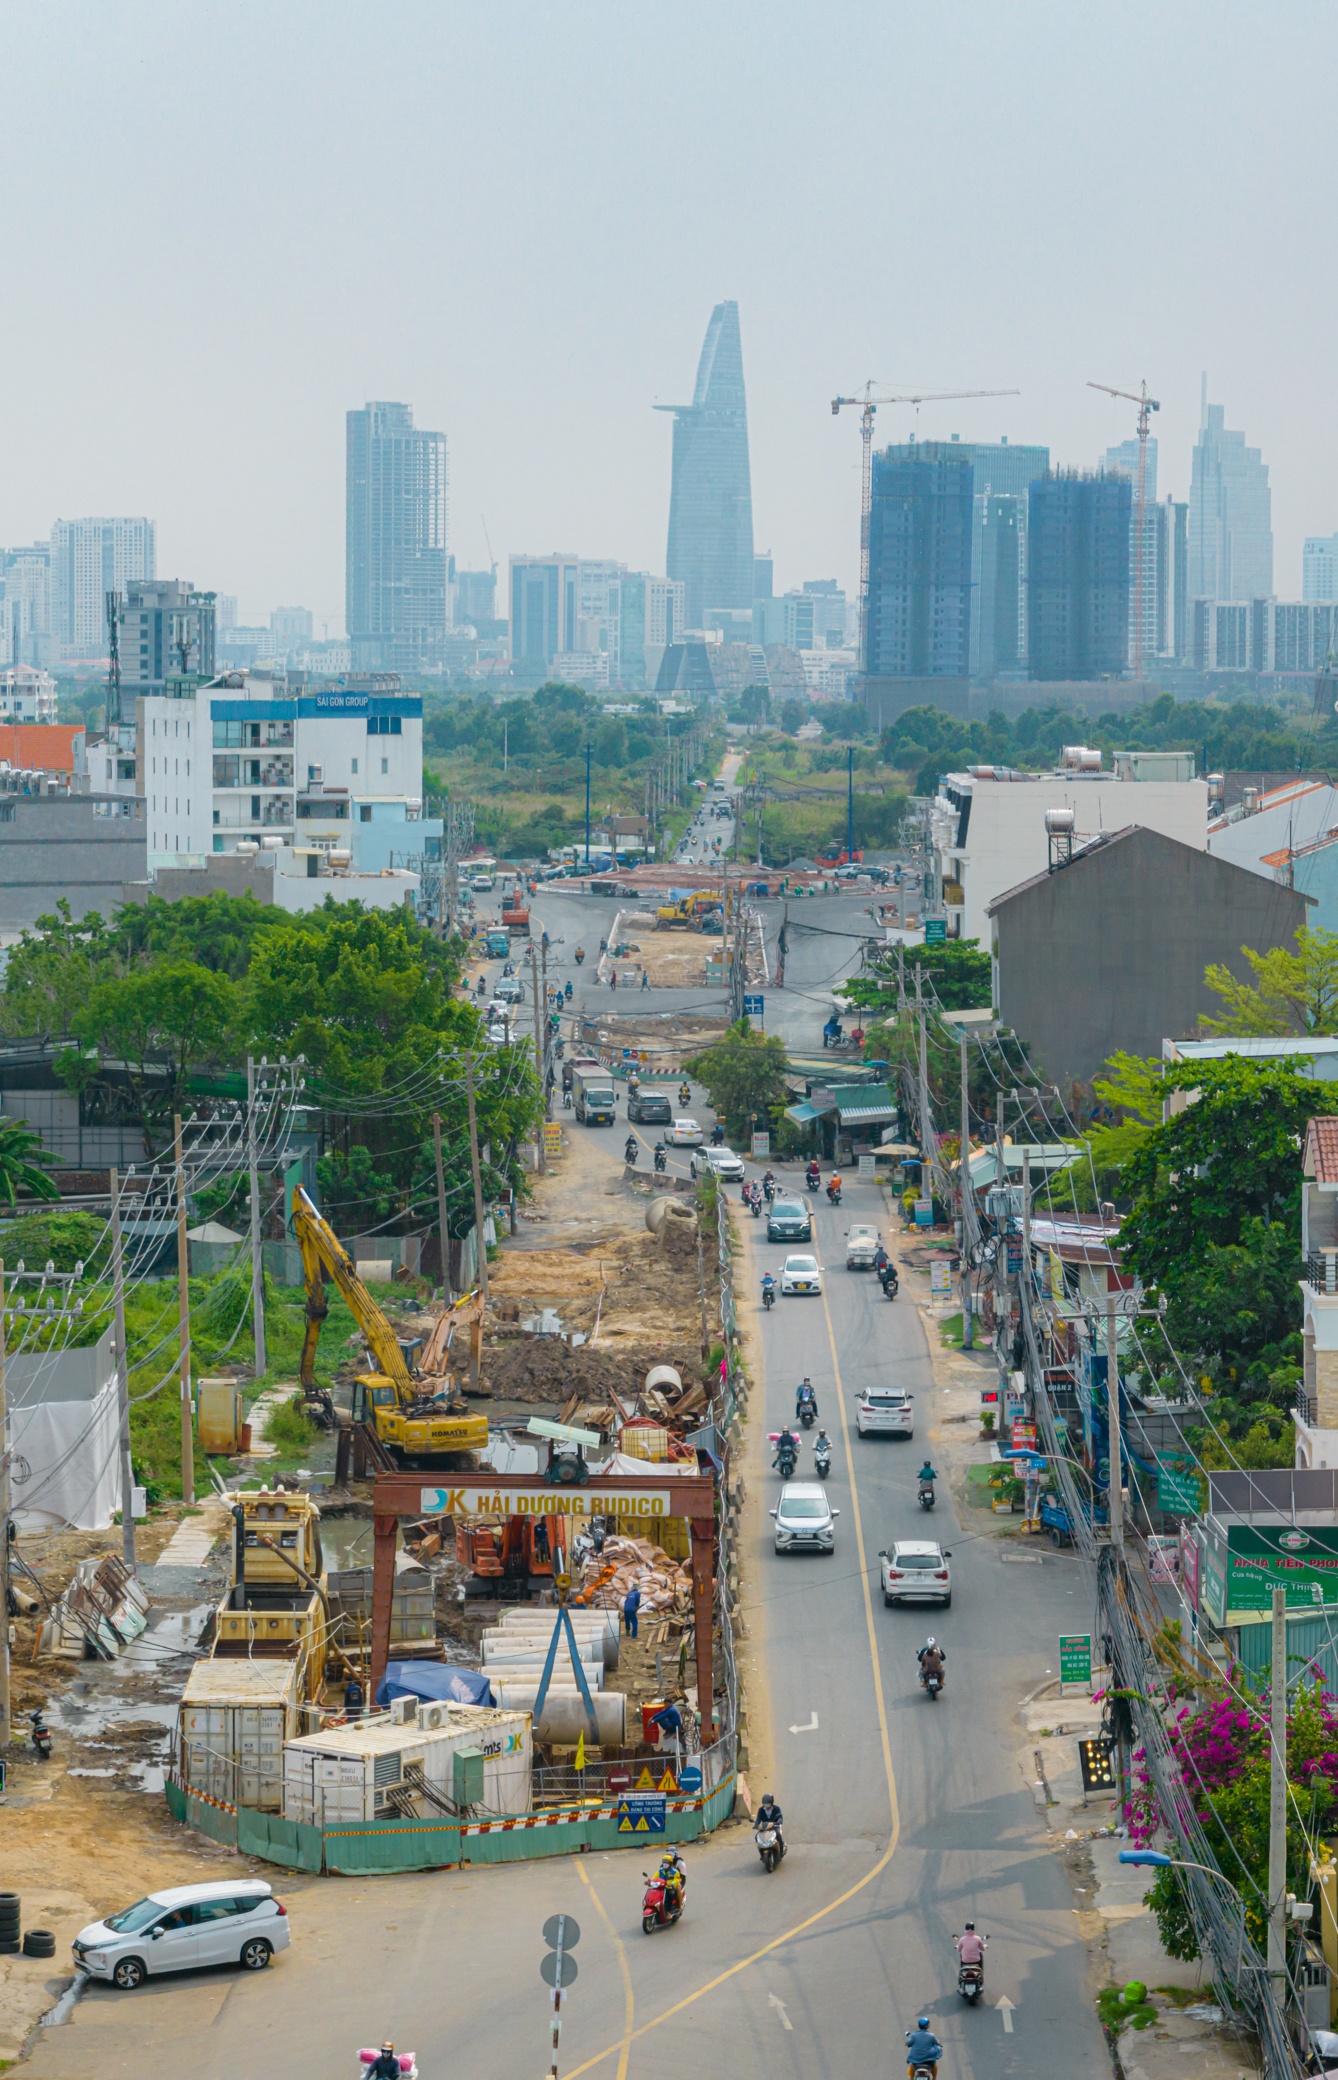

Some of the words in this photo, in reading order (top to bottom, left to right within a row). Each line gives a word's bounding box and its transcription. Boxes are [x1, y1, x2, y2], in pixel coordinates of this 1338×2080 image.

[316, 695, 329, 706] SÀI
[345, 696, 369, 707] GROUP
[431, 1428, 468, 1438] KOMATSU
[477, 1490, 510, 1513] HẢI
[516, 1494, 584, 1515] DƯƠNG
[1233, 1557, 1269, 1570] NHỰA
[483, 1741, 502, 1757] mts
